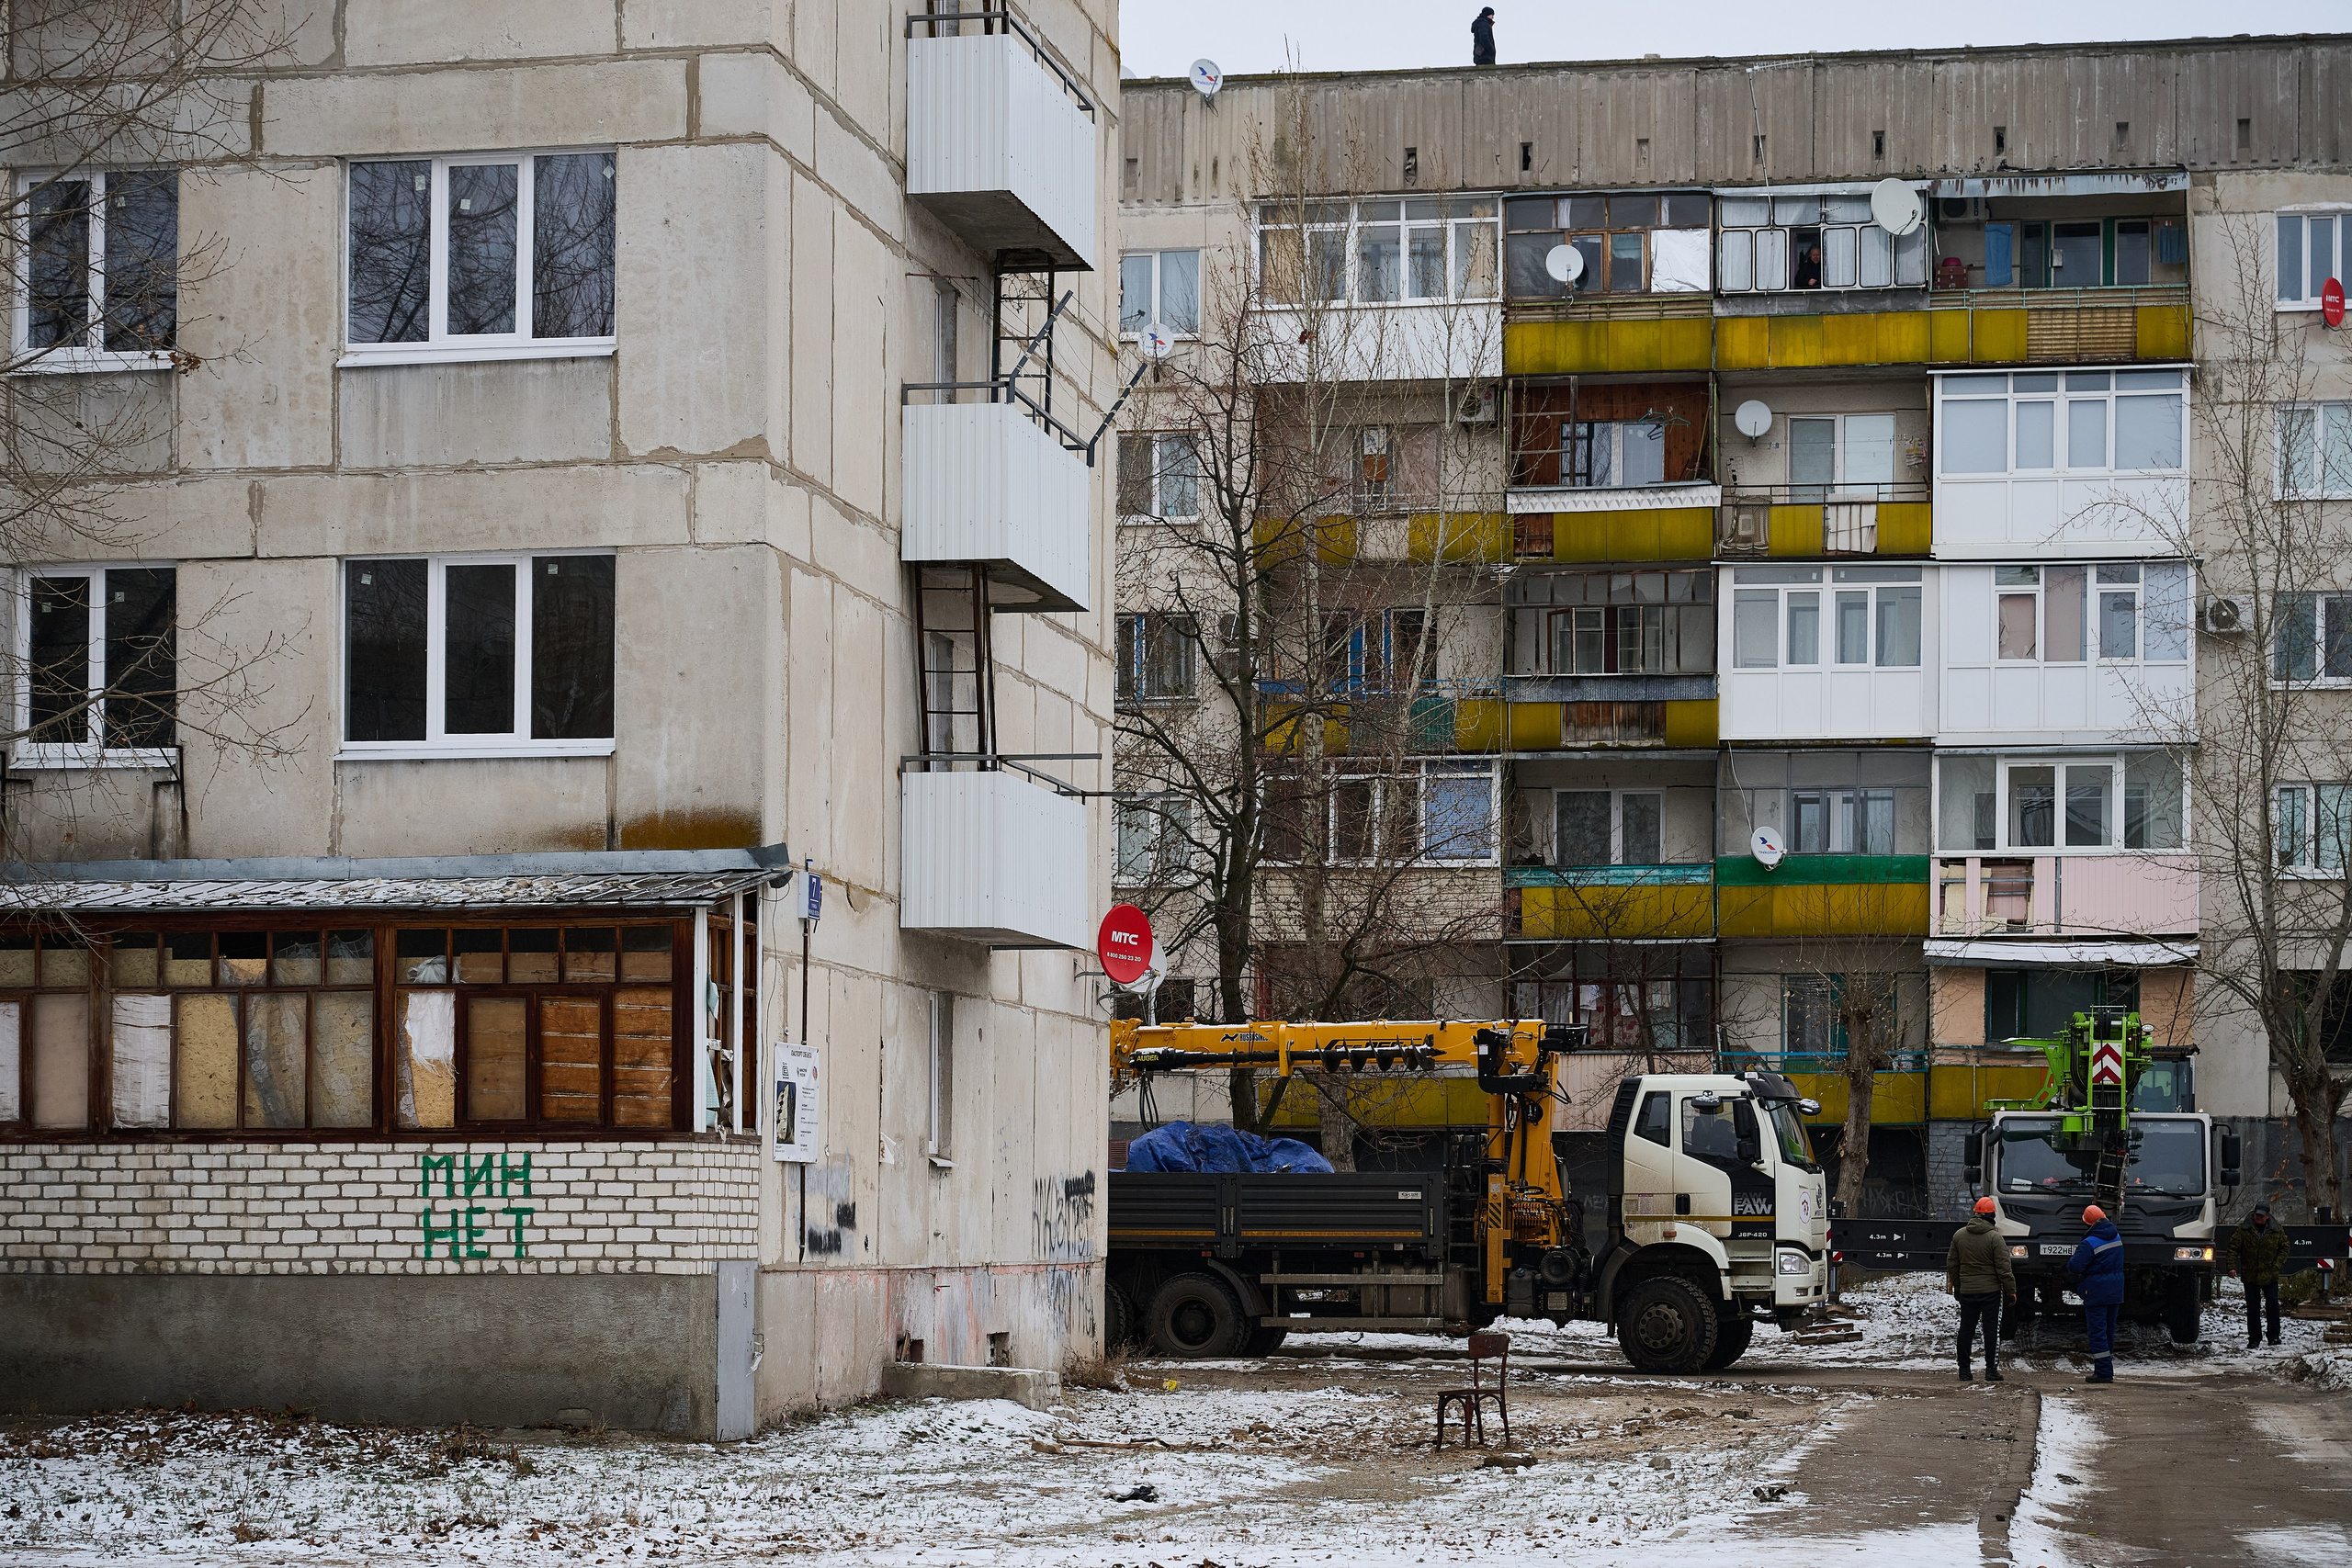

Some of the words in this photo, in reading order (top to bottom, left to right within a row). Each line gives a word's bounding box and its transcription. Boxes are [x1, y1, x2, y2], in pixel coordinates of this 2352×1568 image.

[811, 877, 817, 897] 7
[1111, 931, 1139, 946] МТС
[422, 1152, 531, 1197] МИН
[1734, 1203, 1773, 1215] FAW
[423, 1206, 535, 1263] НЕТ
